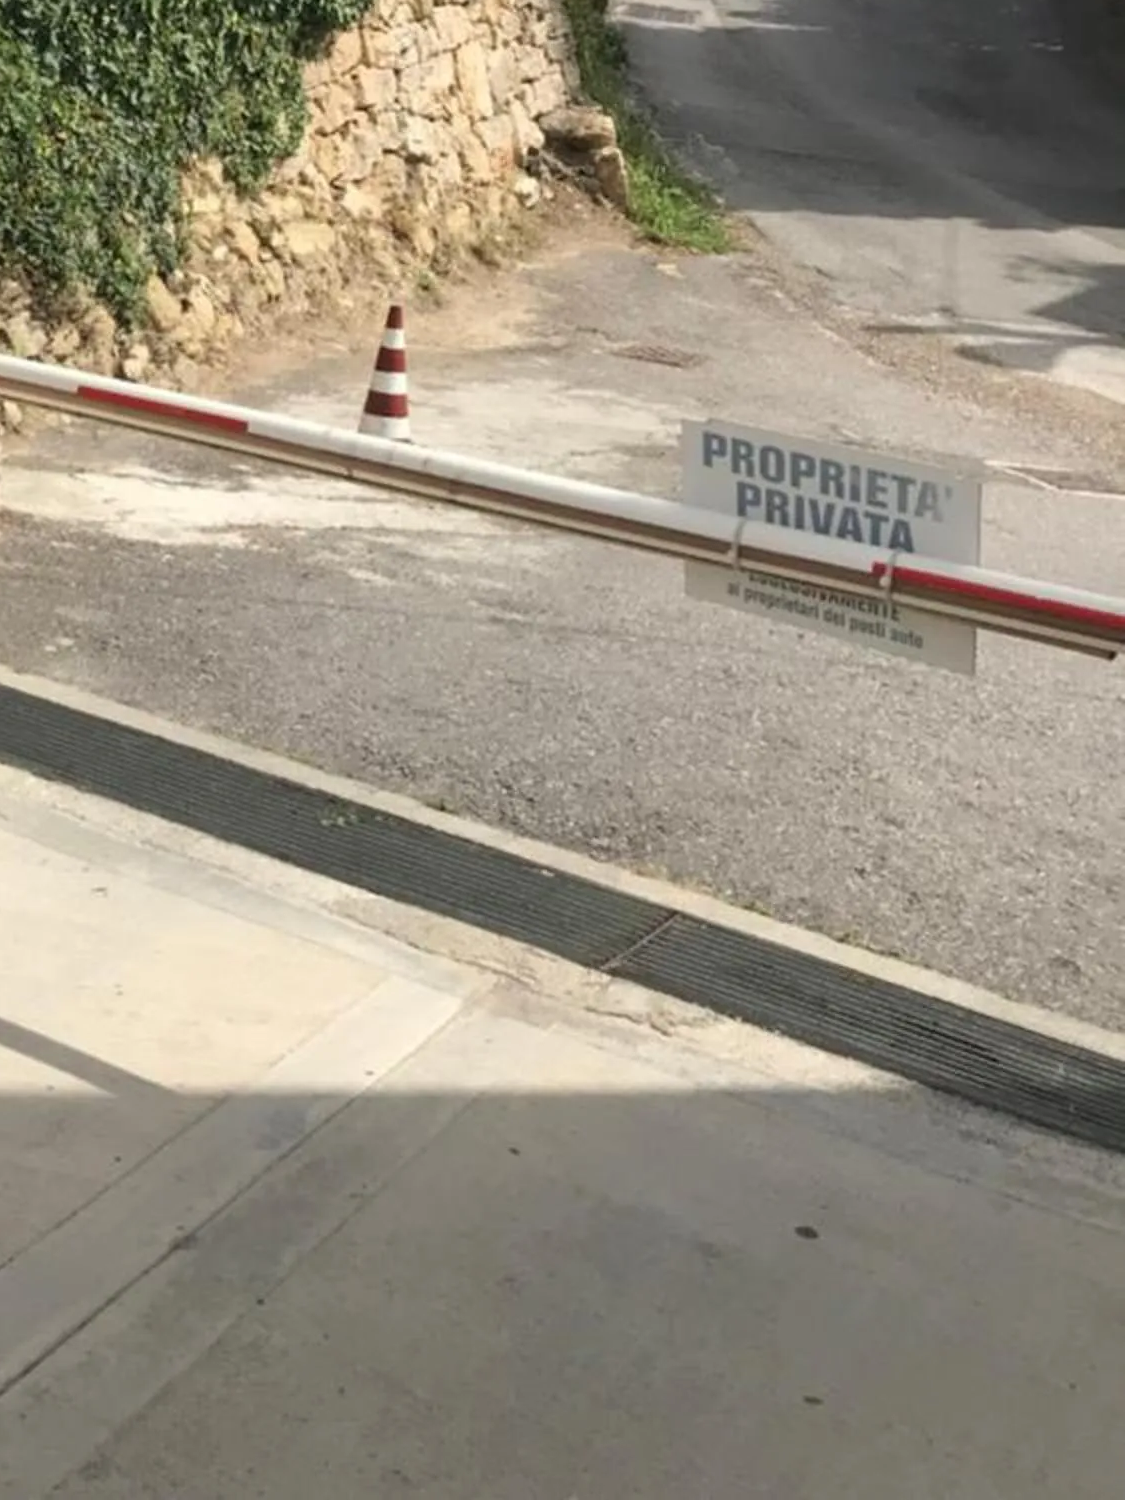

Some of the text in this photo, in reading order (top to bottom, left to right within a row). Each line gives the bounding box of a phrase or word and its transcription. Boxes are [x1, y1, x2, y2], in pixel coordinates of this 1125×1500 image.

[702, 431, 954, 522] PROPRIETA'
[736, 481, 915, 553] PRIVATA
[890, 627, 924, 650] auto
